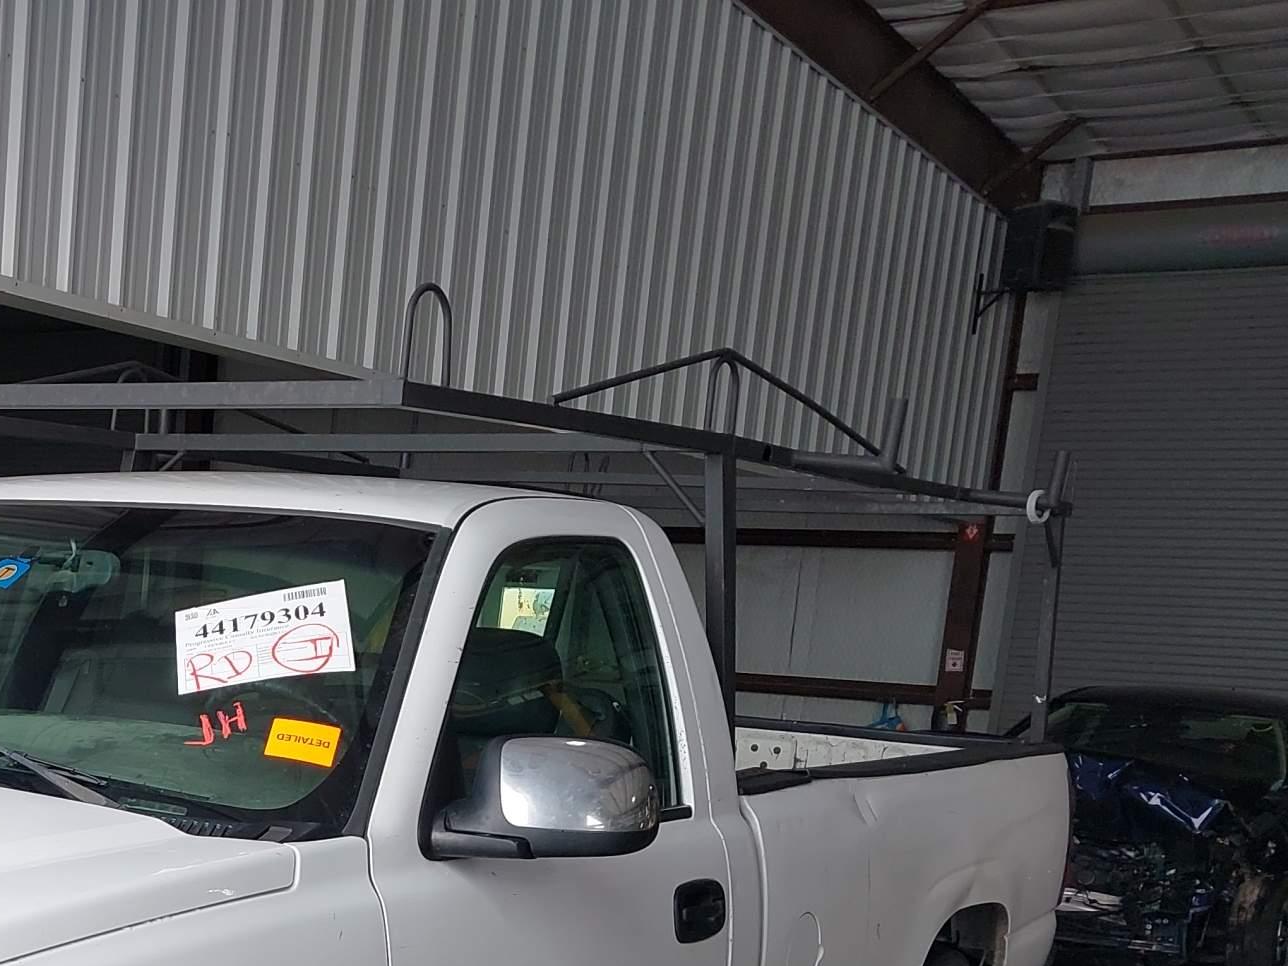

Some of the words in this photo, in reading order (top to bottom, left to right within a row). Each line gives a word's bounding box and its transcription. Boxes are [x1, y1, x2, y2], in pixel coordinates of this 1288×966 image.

[194, 601, 327, 638] 44179304
[186, 649, 253, 691] RD
[183, 700, 248, 746] JH
[276, 732, 331, 749] DETAILED
